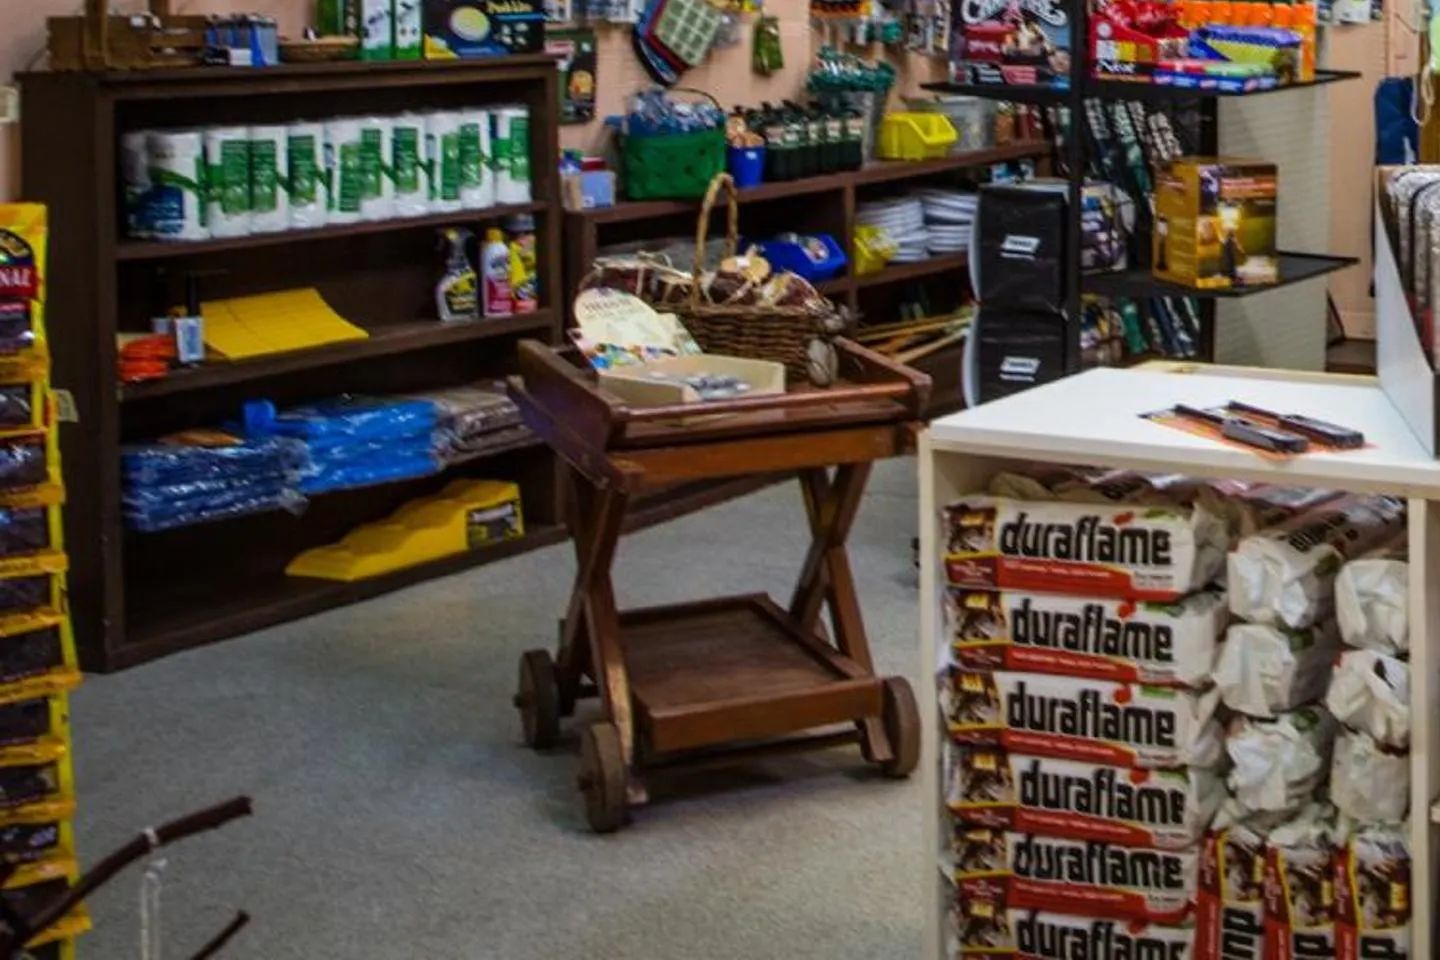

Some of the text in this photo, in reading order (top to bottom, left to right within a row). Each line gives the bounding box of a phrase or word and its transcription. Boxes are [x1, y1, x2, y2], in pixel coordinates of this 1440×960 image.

[999, 510, 1173, 566] duraflame
[1011, 597, 1174, 662] duraflame
[1006, 681, 1177, 747] duraflame
[1020, 759, 1186, 825] duraflame
[1011, 833, 1185, 890] duraflame
